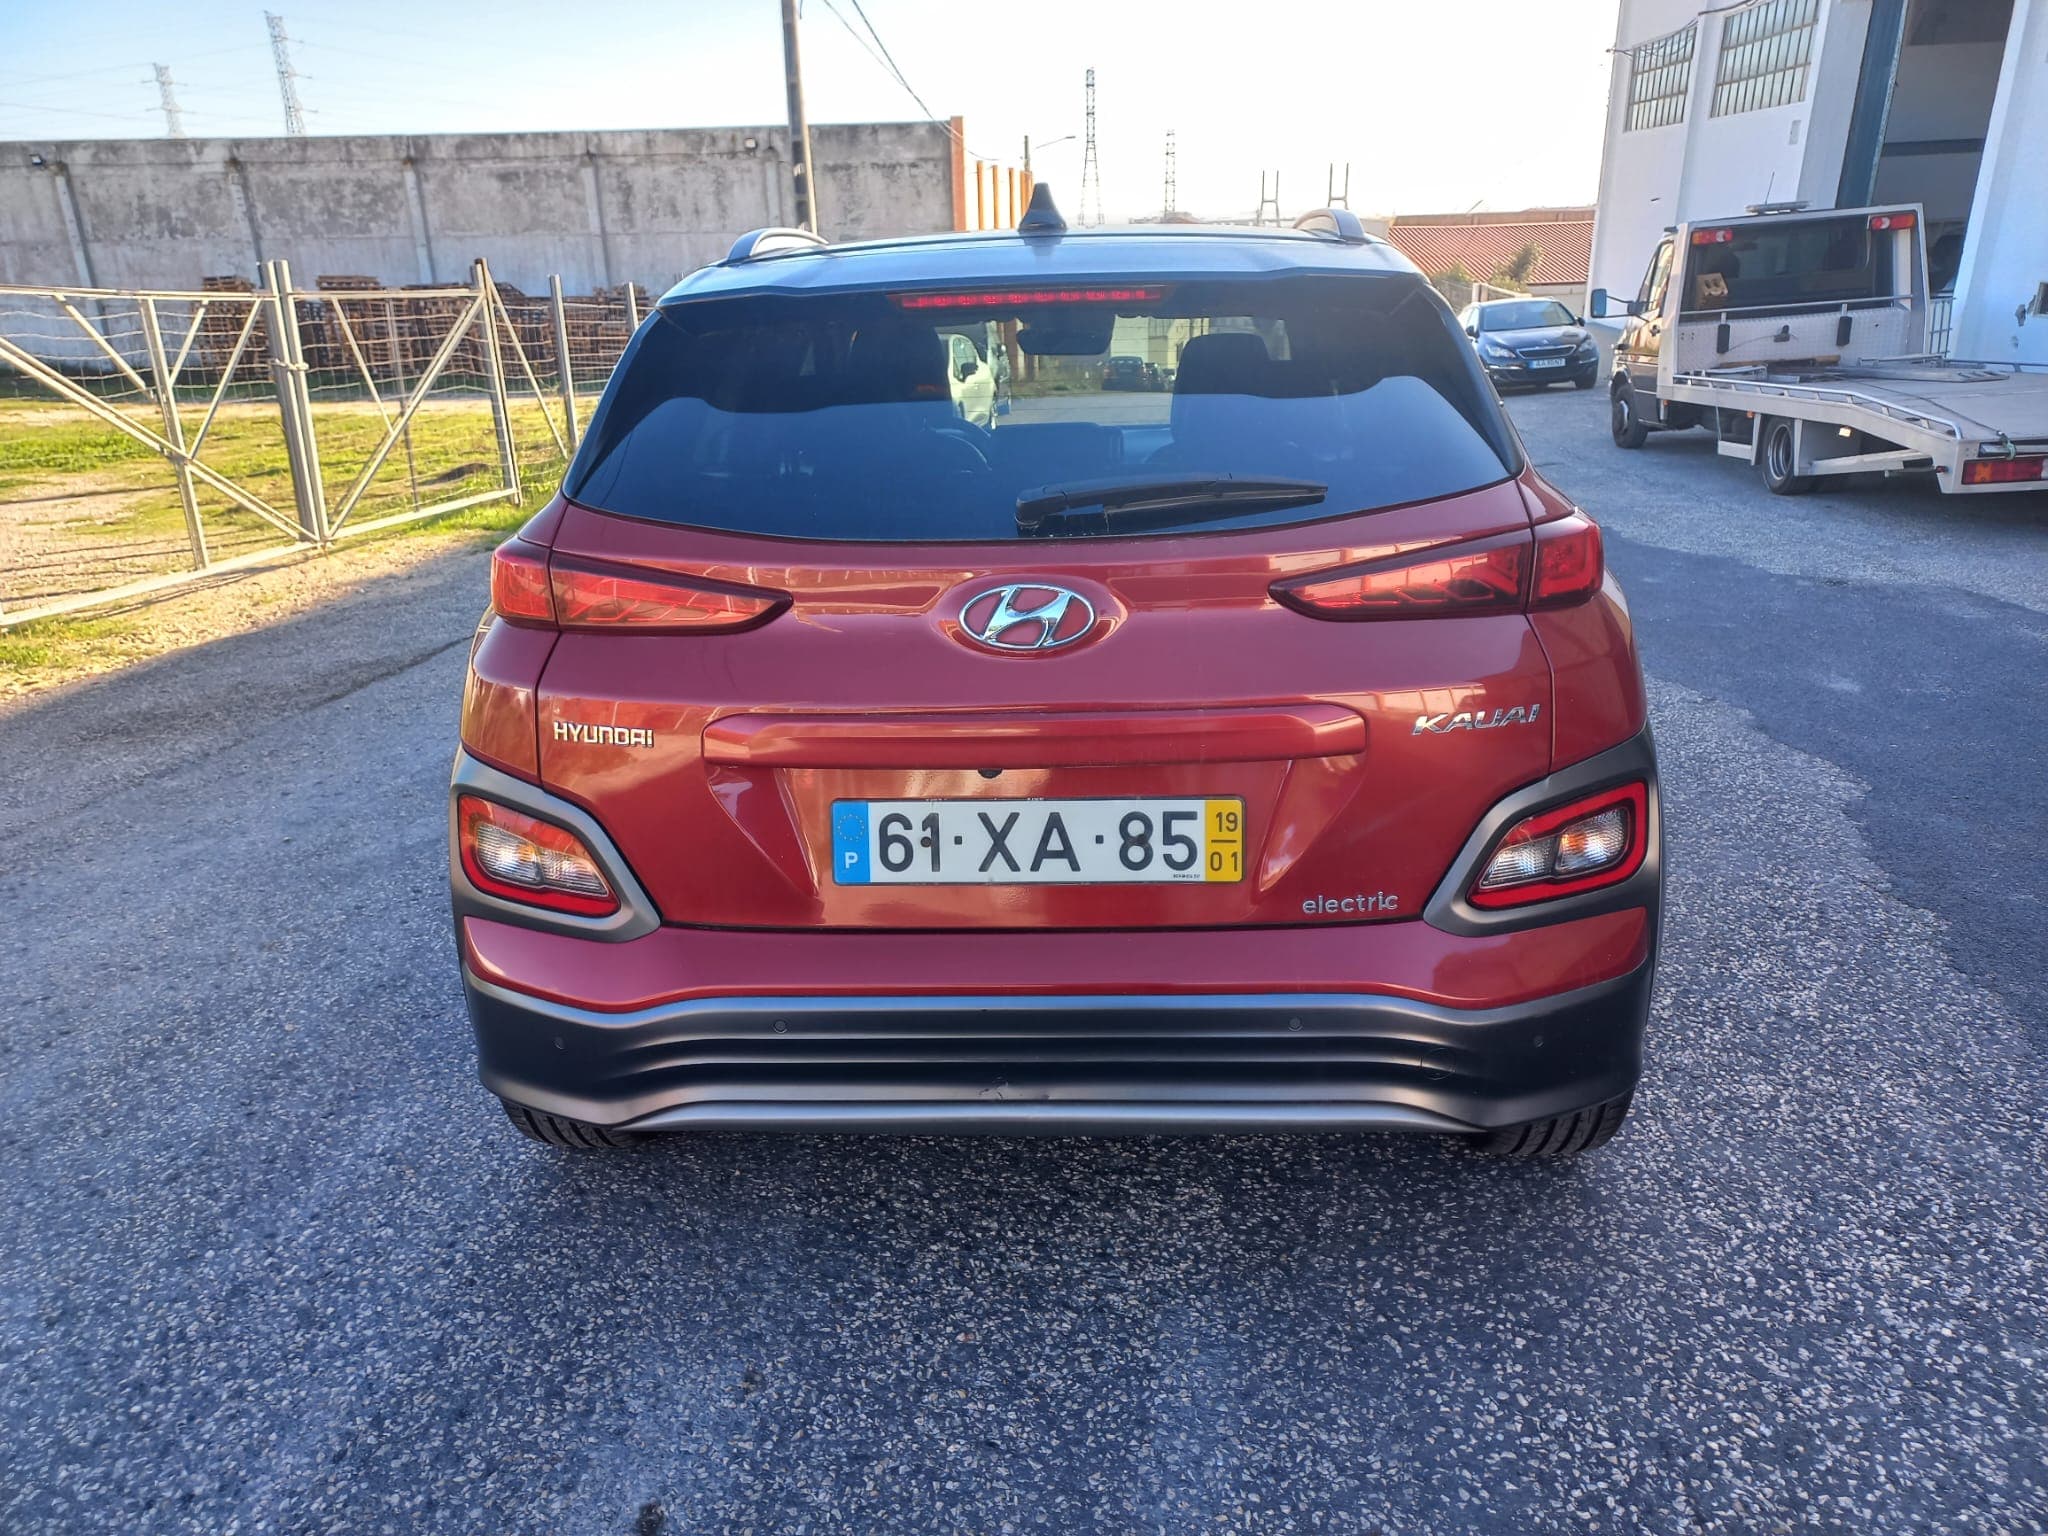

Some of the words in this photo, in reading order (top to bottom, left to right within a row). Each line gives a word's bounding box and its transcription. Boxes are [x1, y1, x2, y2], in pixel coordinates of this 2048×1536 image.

[1411, 703, 1541, 736] KAUAI
[553, 721, 653, 747] HYUNDAI
[1215, 811, 1239, 833] 19
[844, 851, 859, 869] P
[1210, 851, 1238, 872] 01
[1302, 891, 1399, 914] electric
